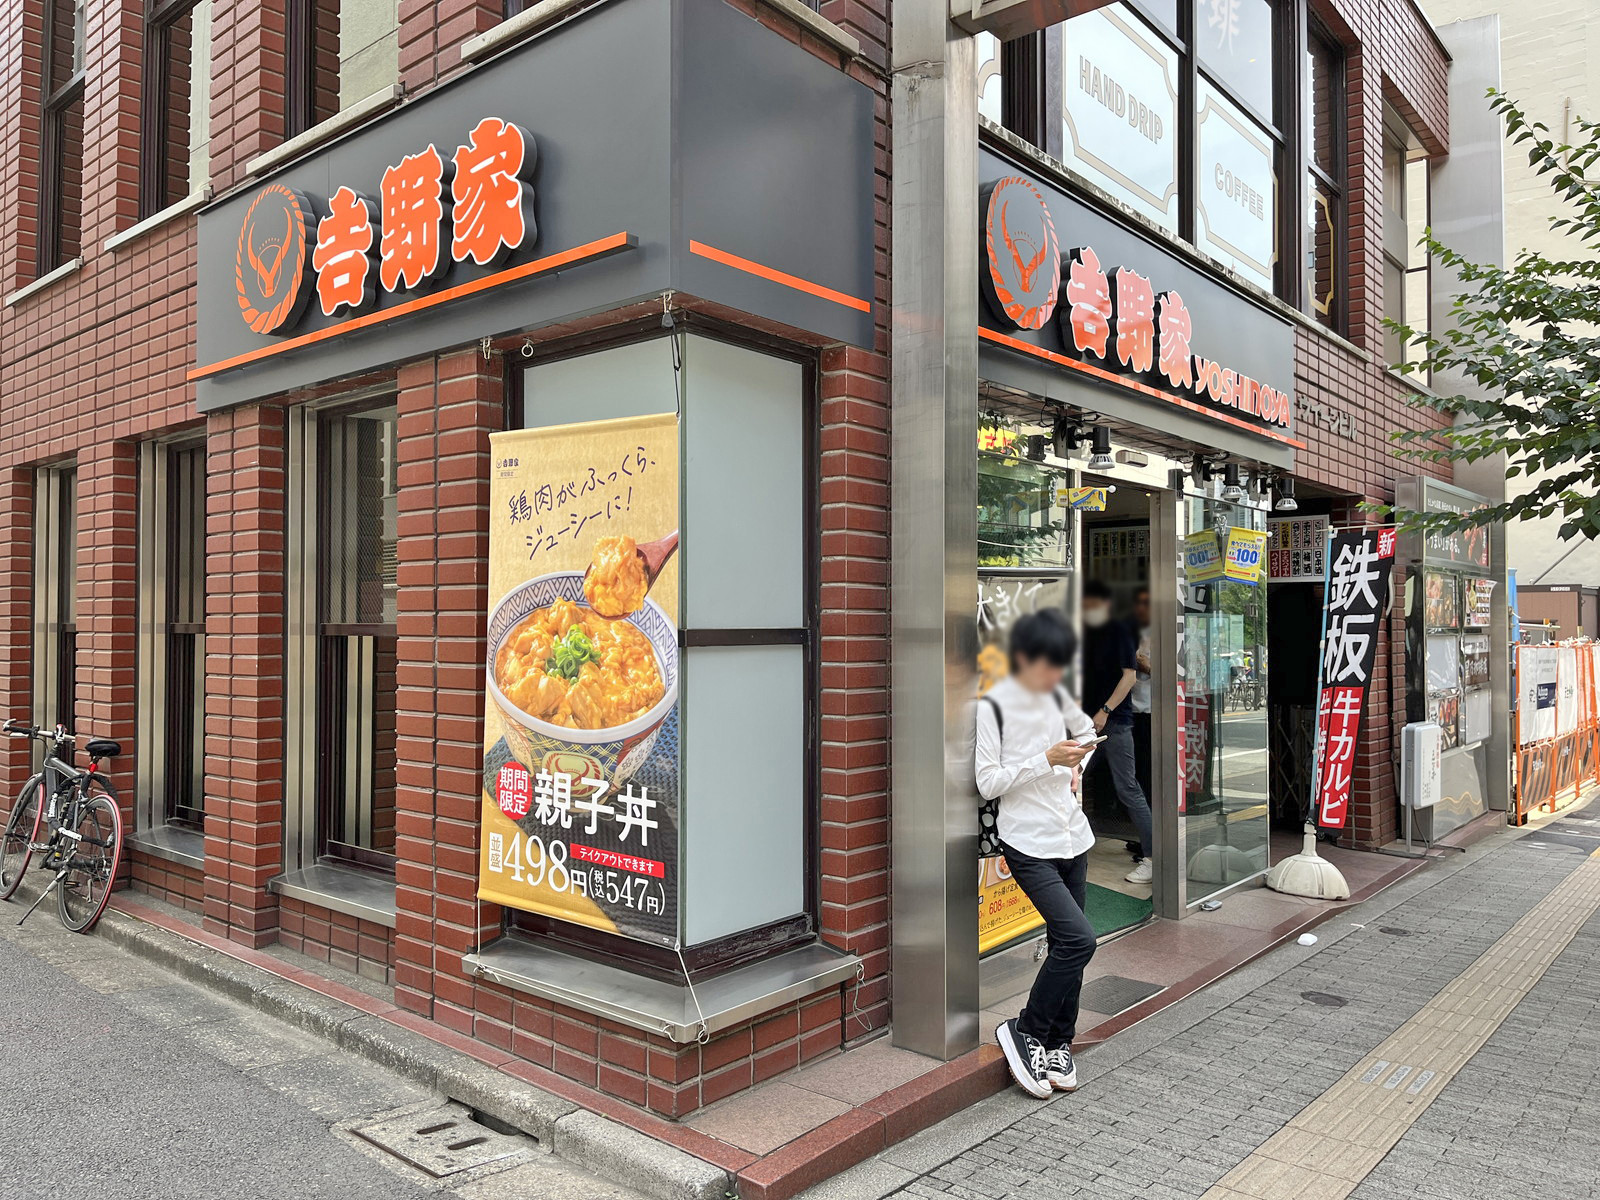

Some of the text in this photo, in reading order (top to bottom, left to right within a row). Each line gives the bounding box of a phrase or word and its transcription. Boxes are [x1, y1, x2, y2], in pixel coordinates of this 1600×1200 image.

[1079, 54, 1163, 145] HAND DRIP
[313, 117, 525, 316] 吉野家
[1214, 162, 1264, 221] COFFEE
[1067, 246, 1291, 428] 吉野家 YOSHINOYA
[508, 446, 656, 525] 鶏肉がふっくら、
[1236, 549, 1258, 564] 100
[1379, 531, 1395, 556] 新
[1325, 539, 1380, 683] 鉄板
[499, 766, 529, 792] 期間
[1322, 690, 1360, 824] 牛カルビ
[499, 789, 528, 816] 限定
[535, 768, 658, 846] 親子丼
[490, 837, 502, 868] 並盛
[579, 847, 655, 874] テイクアウトできます
